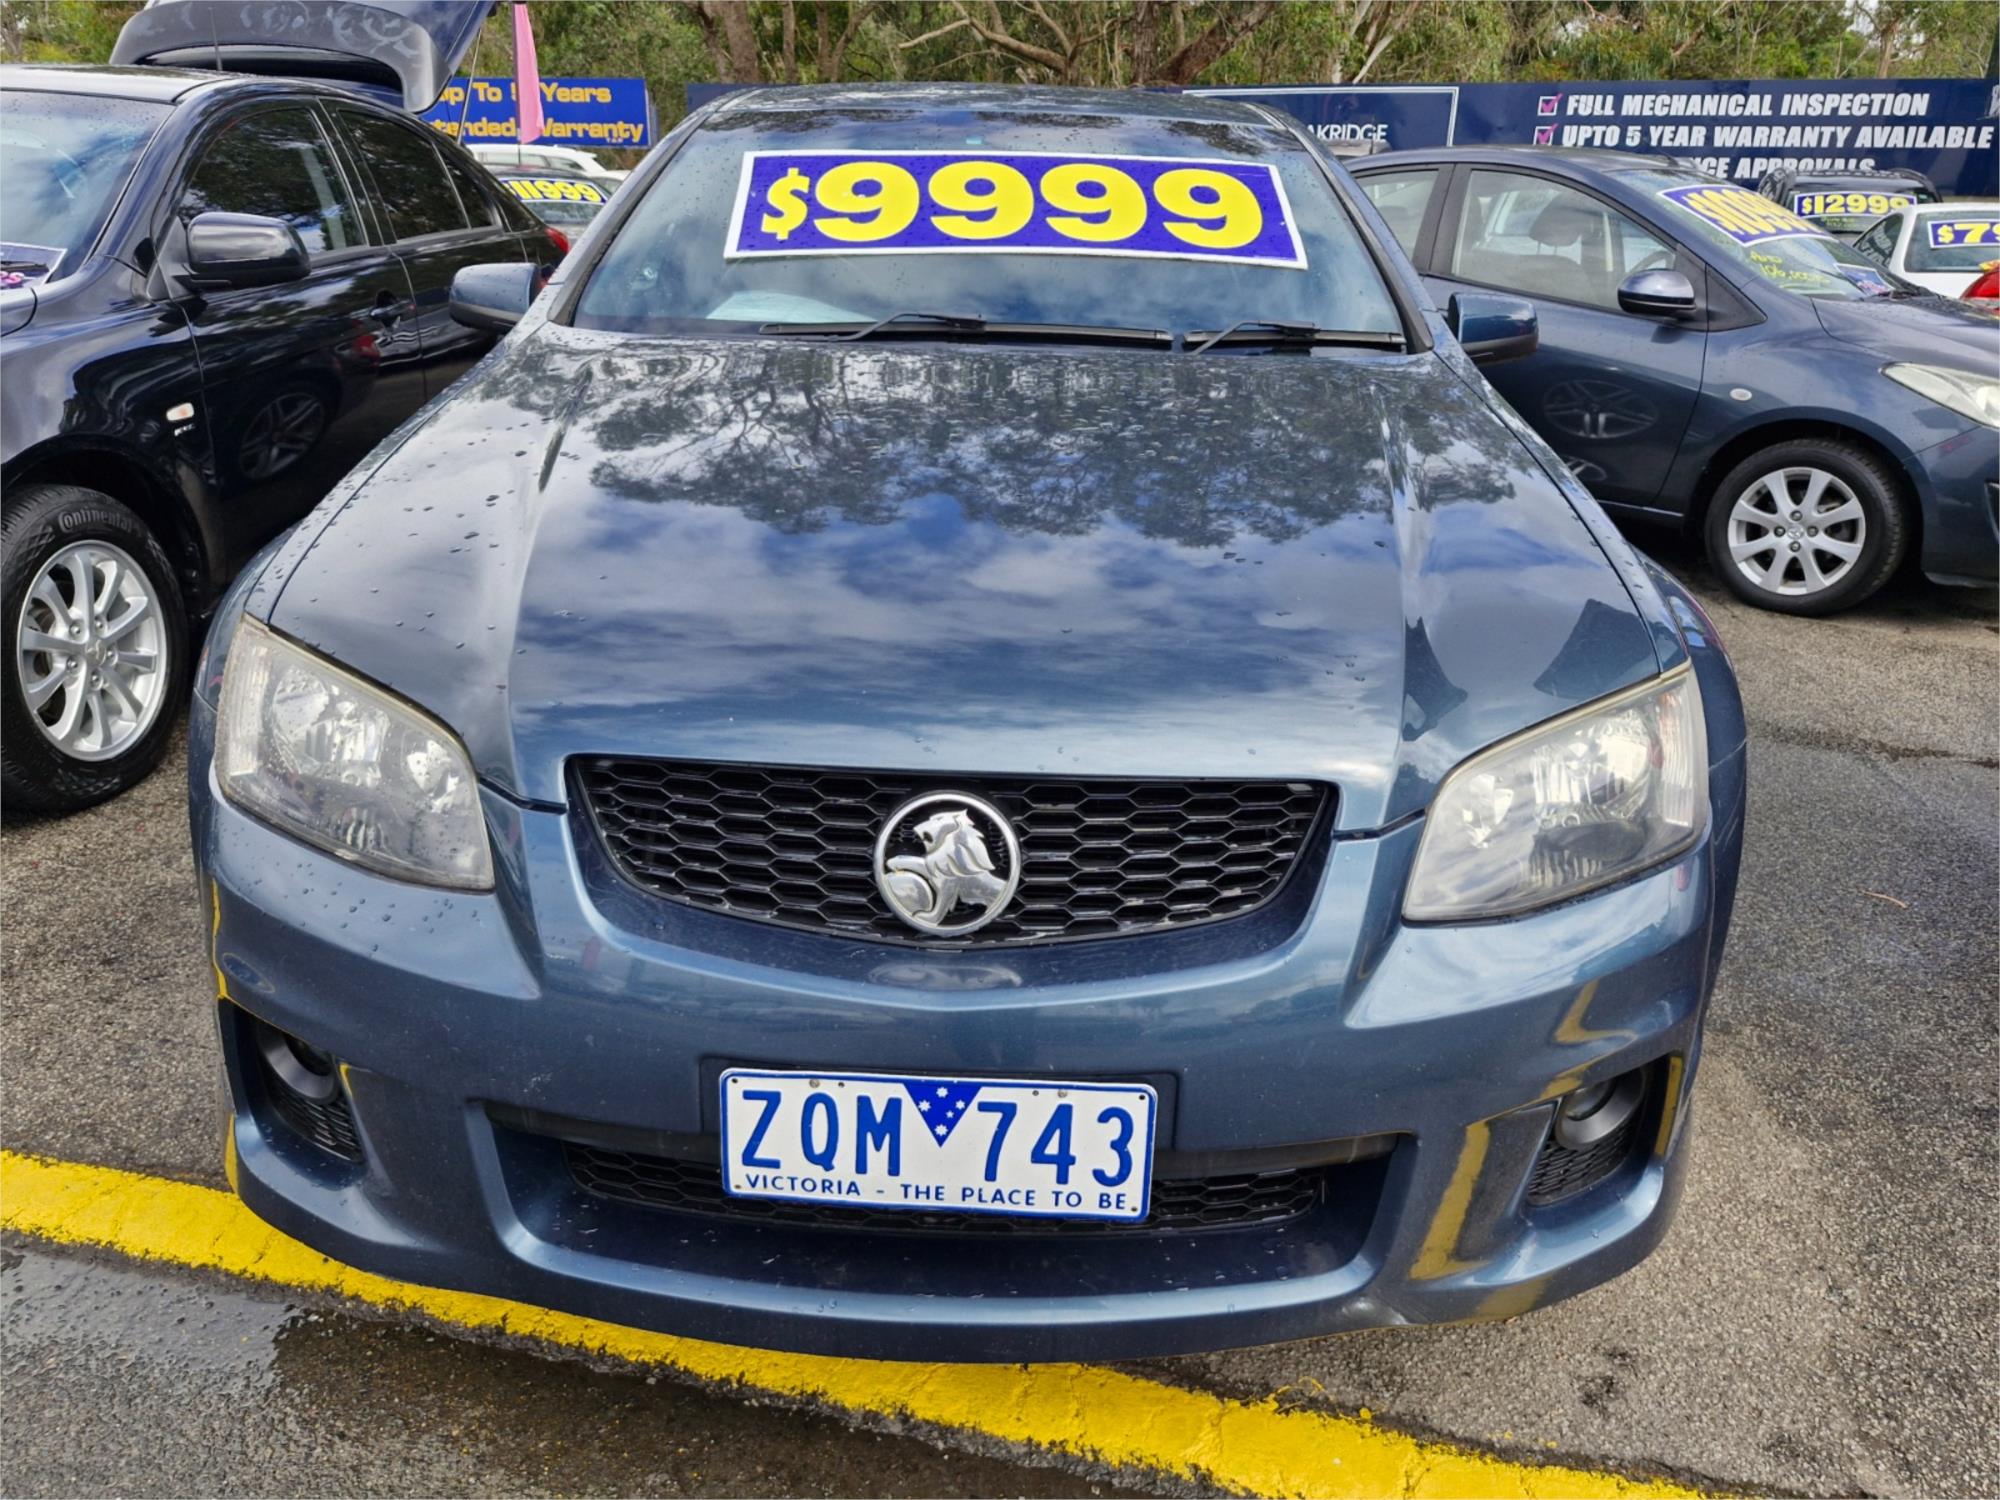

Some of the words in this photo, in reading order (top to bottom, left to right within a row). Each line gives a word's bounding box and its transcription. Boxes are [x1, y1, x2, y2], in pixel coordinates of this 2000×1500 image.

[472, 82, 503, 102] To
[540, 83, 612, 103] Years
[1566, 94, 1614, 116] FULL
[1621, 94, 1772, 116] MECHANICAL
[1780, 93, 1930, 116] INSPECTION
[429, 117, 516, 136] tended
[1562, 125, 1620, 147] UPTO
[1625, 125, 1642, 147] 5
[1650, 125, 1707, 147] YEAR
[1713, 125, 1852, 148] WARRANTY
[1854, 125, 1995, 148] AVAILABLE
[760, 161, 1263, 249] $9999
[741, 1089, 903, 1177] ZQM
[977, 1101, 1134, 1187] 743
[745, 1174, 861, 1197] VICTORIA
[900, 1183, 945, 1202] THE
[961, 1187, 1036, 1206] PLACE
[1052, 1190, 1083, 1208] TO
[1099, 1192, 1127, 1211] BE
